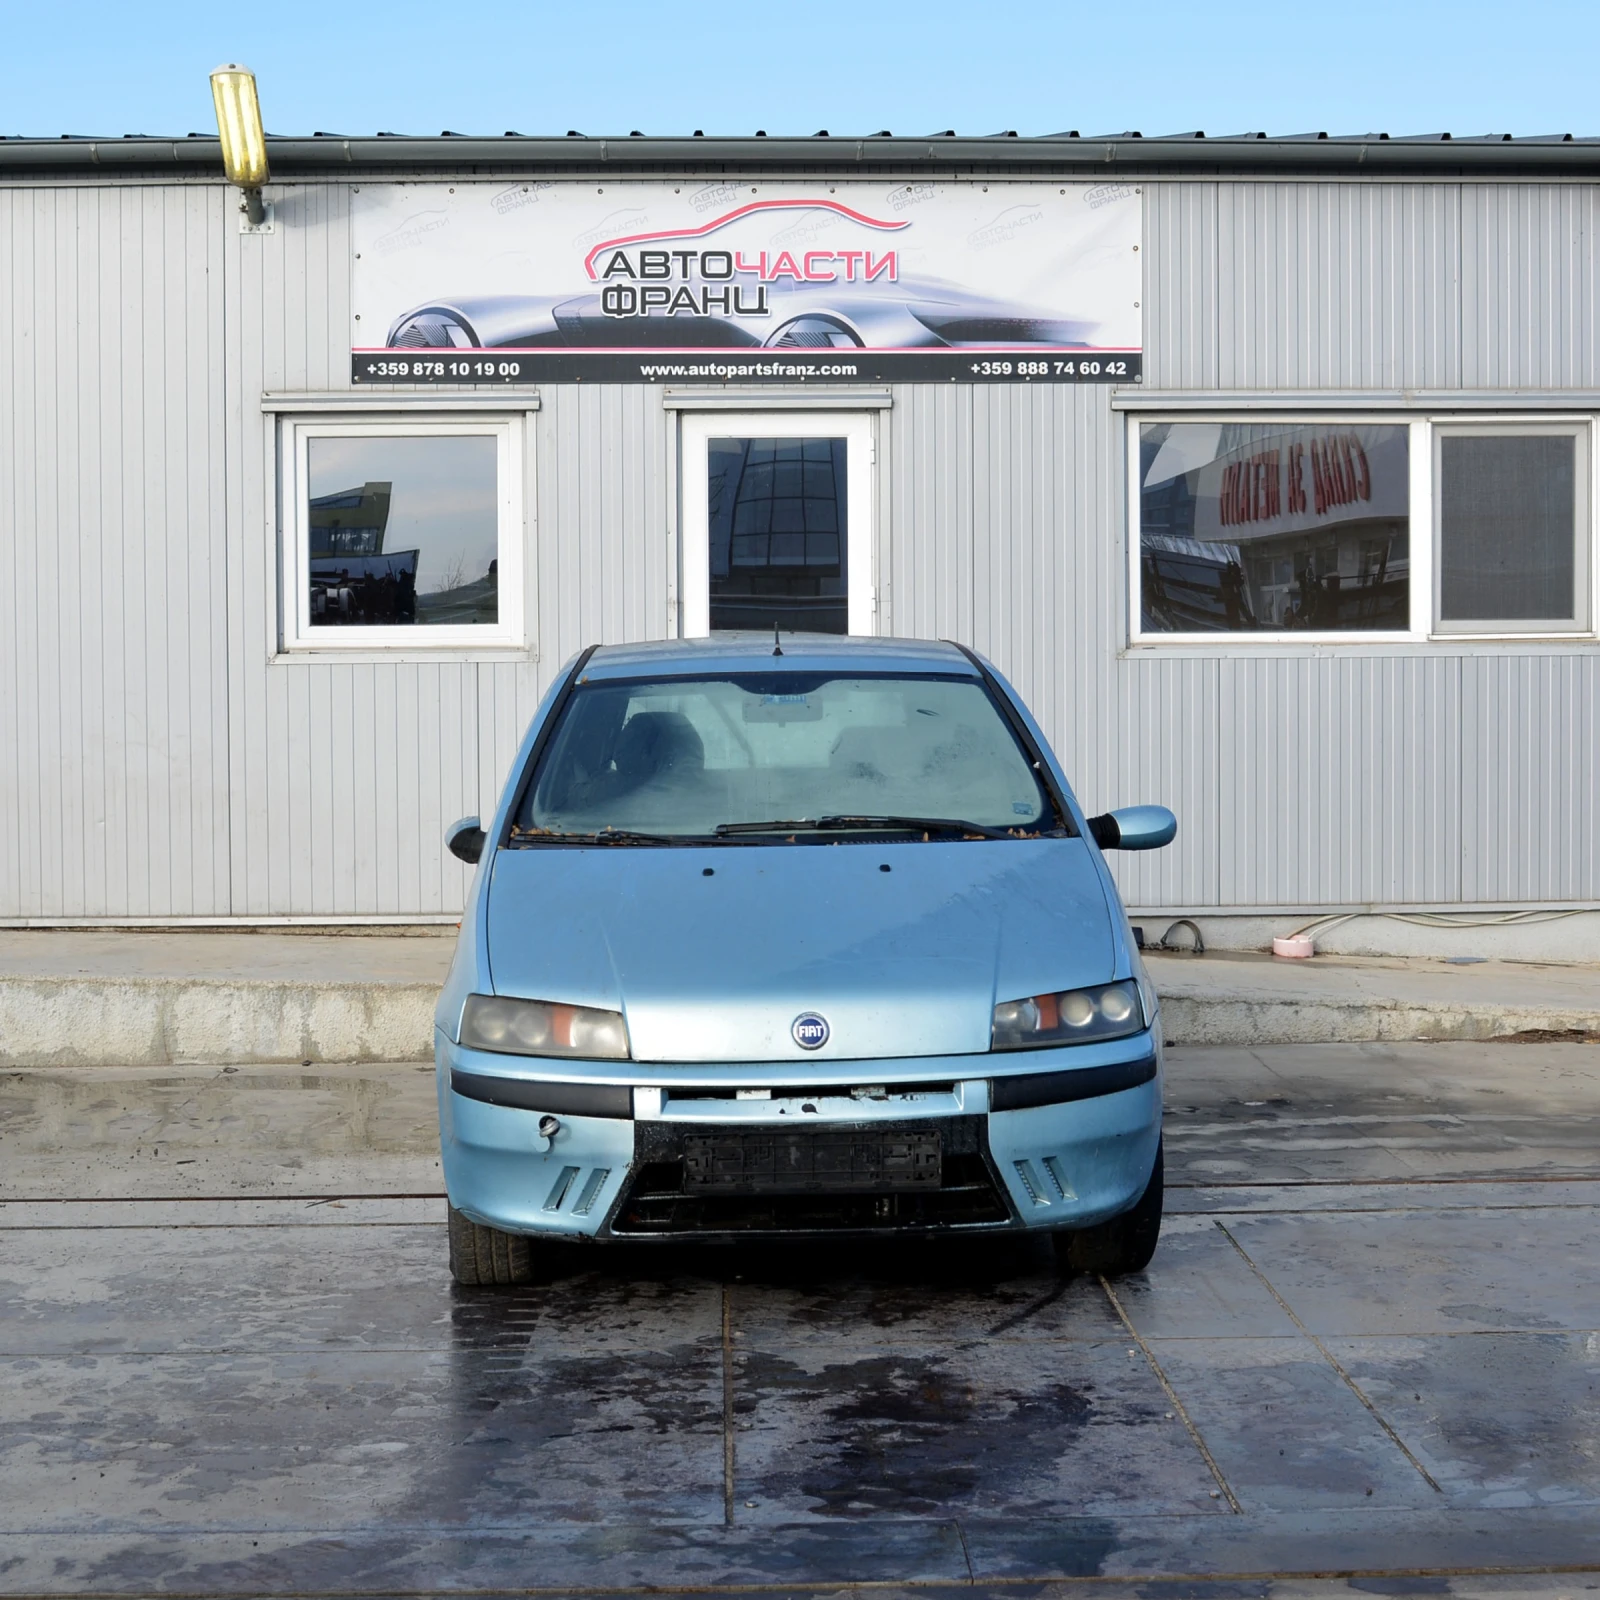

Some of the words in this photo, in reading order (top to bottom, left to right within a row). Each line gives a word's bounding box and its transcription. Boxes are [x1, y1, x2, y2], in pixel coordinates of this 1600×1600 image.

[497, 194, 539, 214] ФРАНЦ
[695, 193, 737, 213] ФРАНЦ
[893, 190, 935, 211] ФРАНЦ
[1090, 189, 1132, 209] ФРАНЦ
[602, 251, 897, 280] АВТОЧАСТИ
[602, 284, 769, 316] ФРАНЦ
[367, 362, 409, 376] +359
[412, 362, 445, 376] 878
[449, 362, 470, 376] 10
[474, 362, 495, 376] 19
[498, 362, 520, 376] 00
[640, 362, 858, 378] www.autopartsfranz.com
[970, 361, 1013, 375] +359
[1017, 361, 1049, 375] 888
[1053, 361, 1075, 375] 74
[1079, 361, 1101, 375] 60
[1105, 361, 1127, 375] 42
[798, 1025, 823, 1038] FIAT
